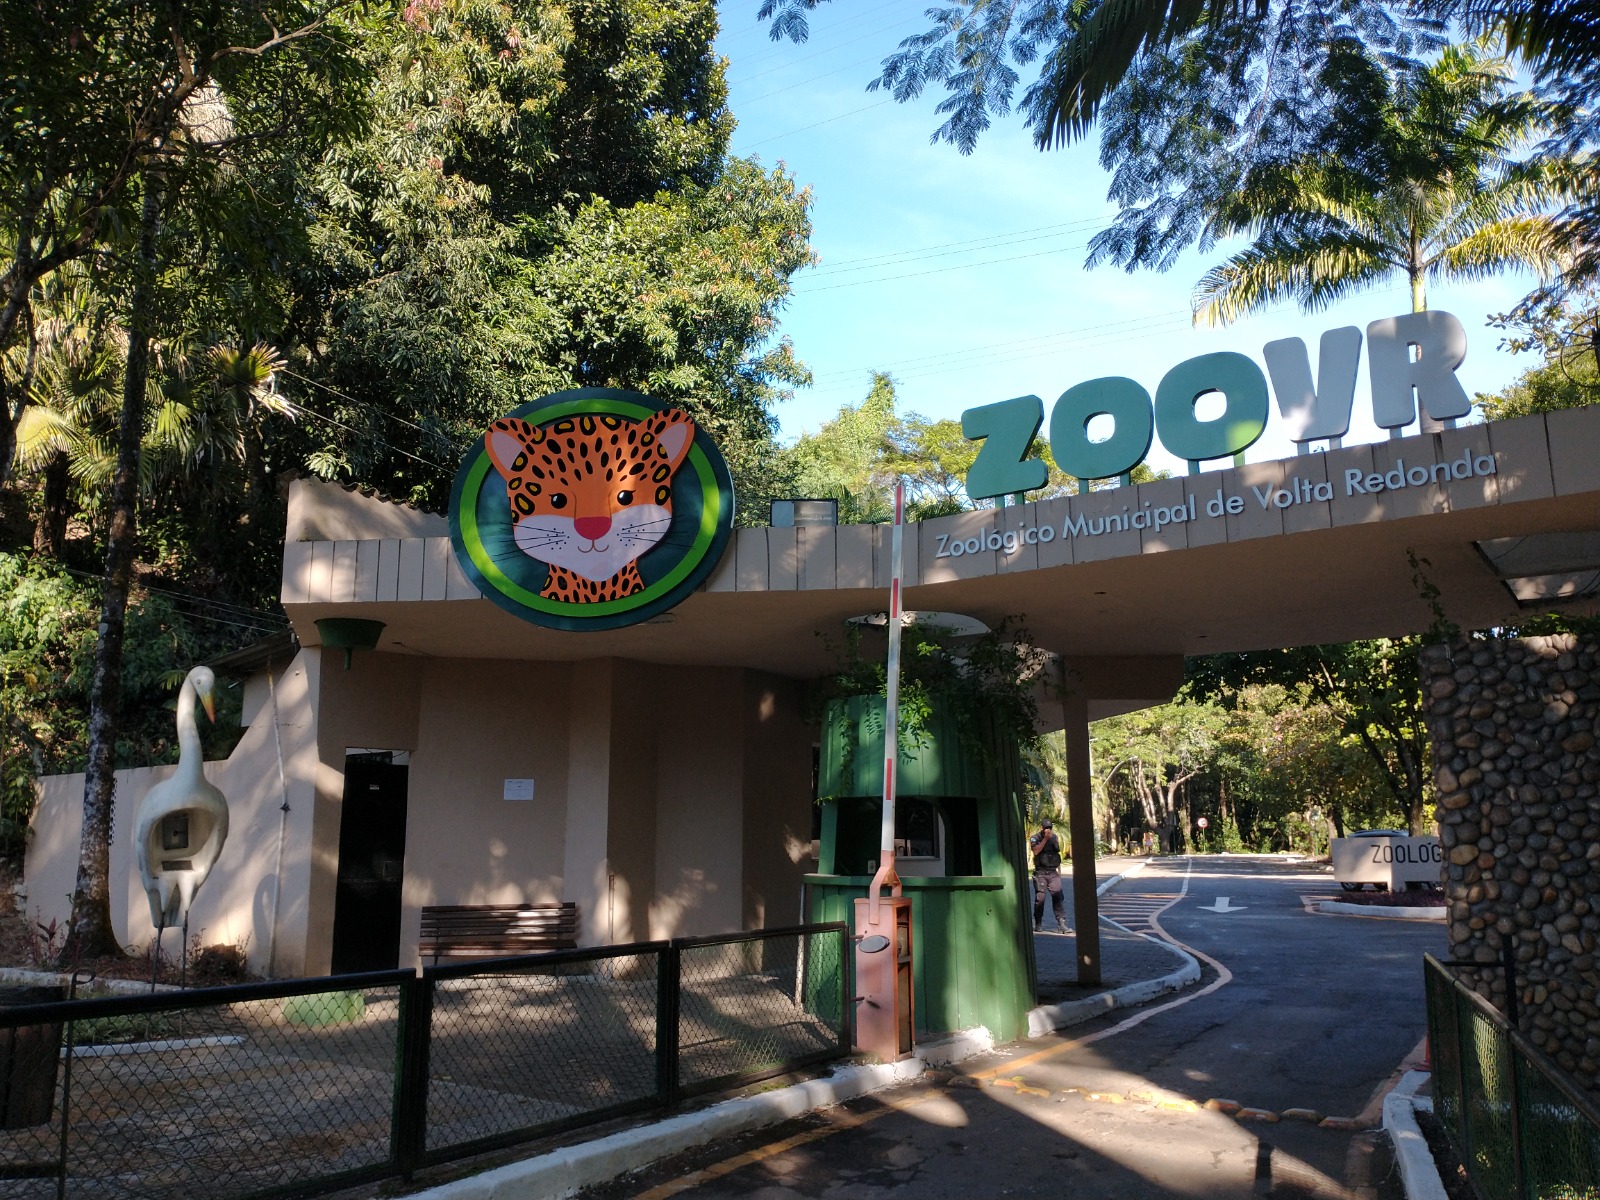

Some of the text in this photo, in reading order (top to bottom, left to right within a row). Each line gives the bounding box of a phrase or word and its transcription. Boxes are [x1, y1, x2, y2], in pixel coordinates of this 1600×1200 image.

[962, 310, 1472, 499] ZOOVR
[936, 449, 1497, 558] Zoológico Municipal de Volta Redonda
